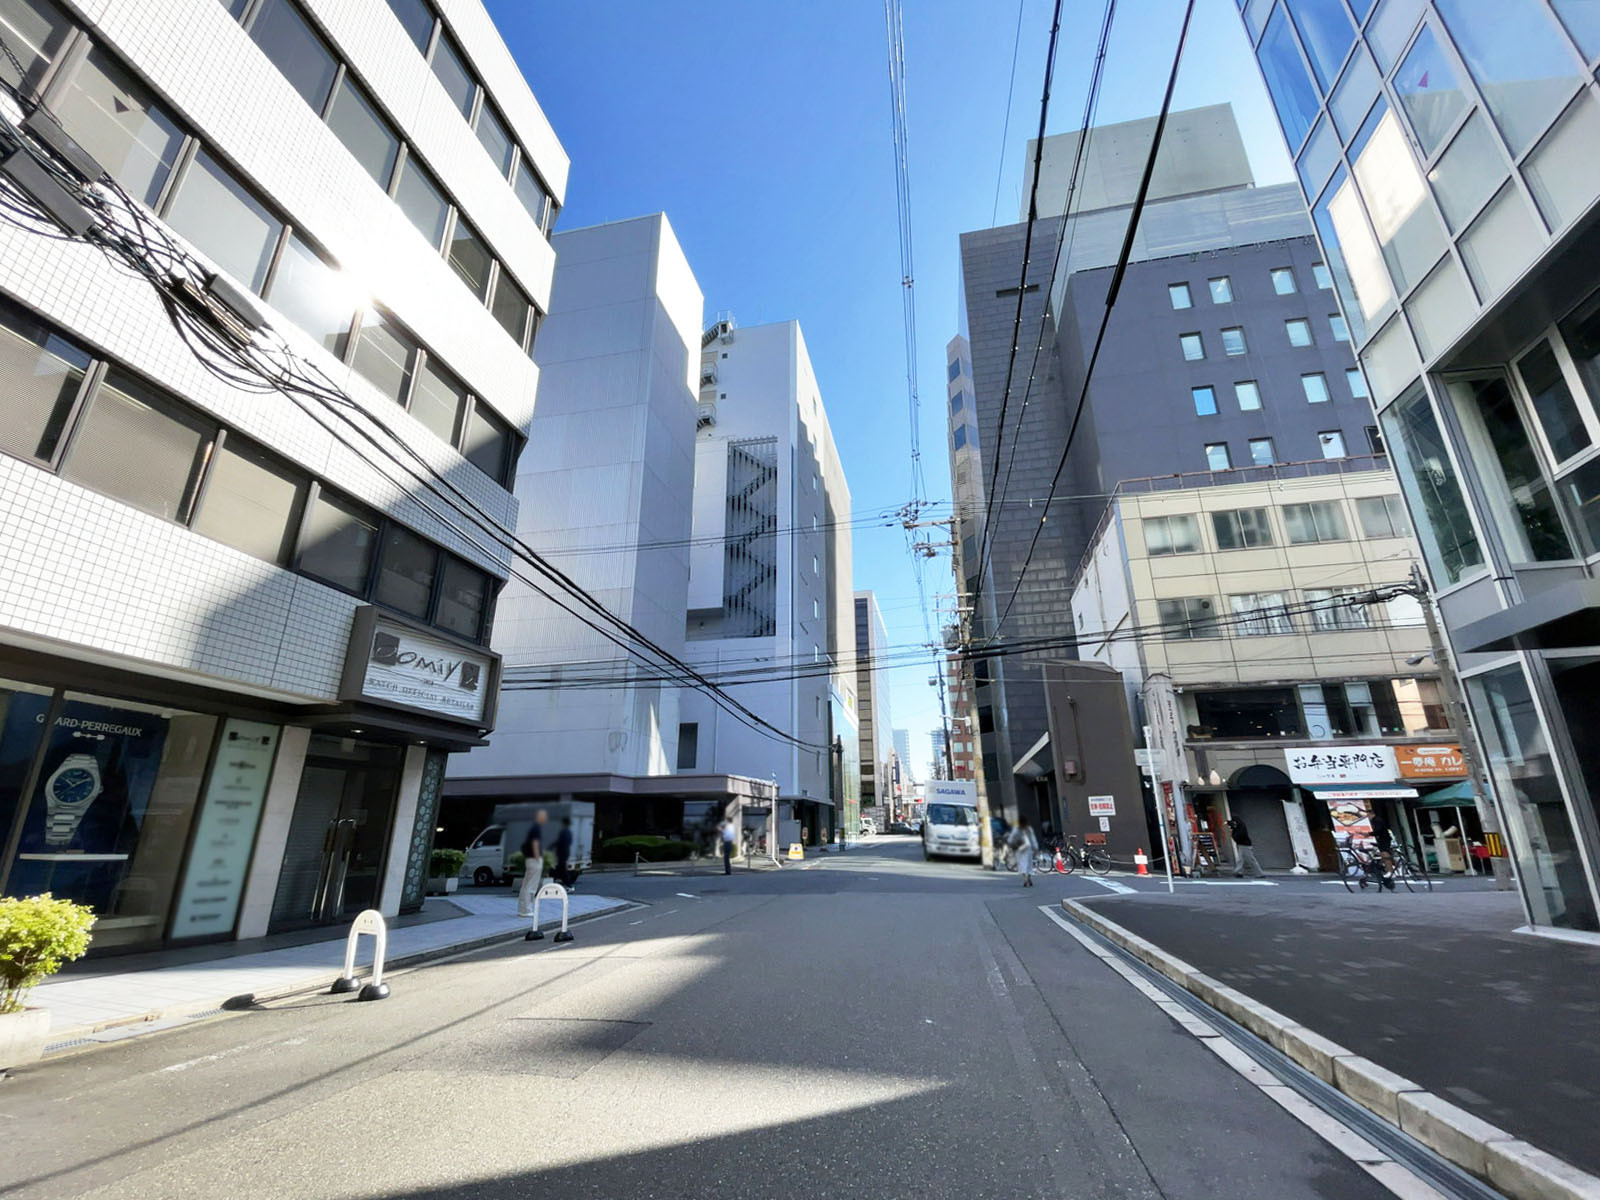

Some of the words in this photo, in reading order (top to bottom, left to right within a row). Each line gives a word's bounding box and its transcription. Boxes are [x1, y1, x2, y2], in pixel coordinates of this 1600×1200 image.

[36, 713, 142, 737] GARD-PERREGAUX
[1293, 752, 1385, 770] お弁当専門店
[936, 788, 966, 796] SAGAWA
